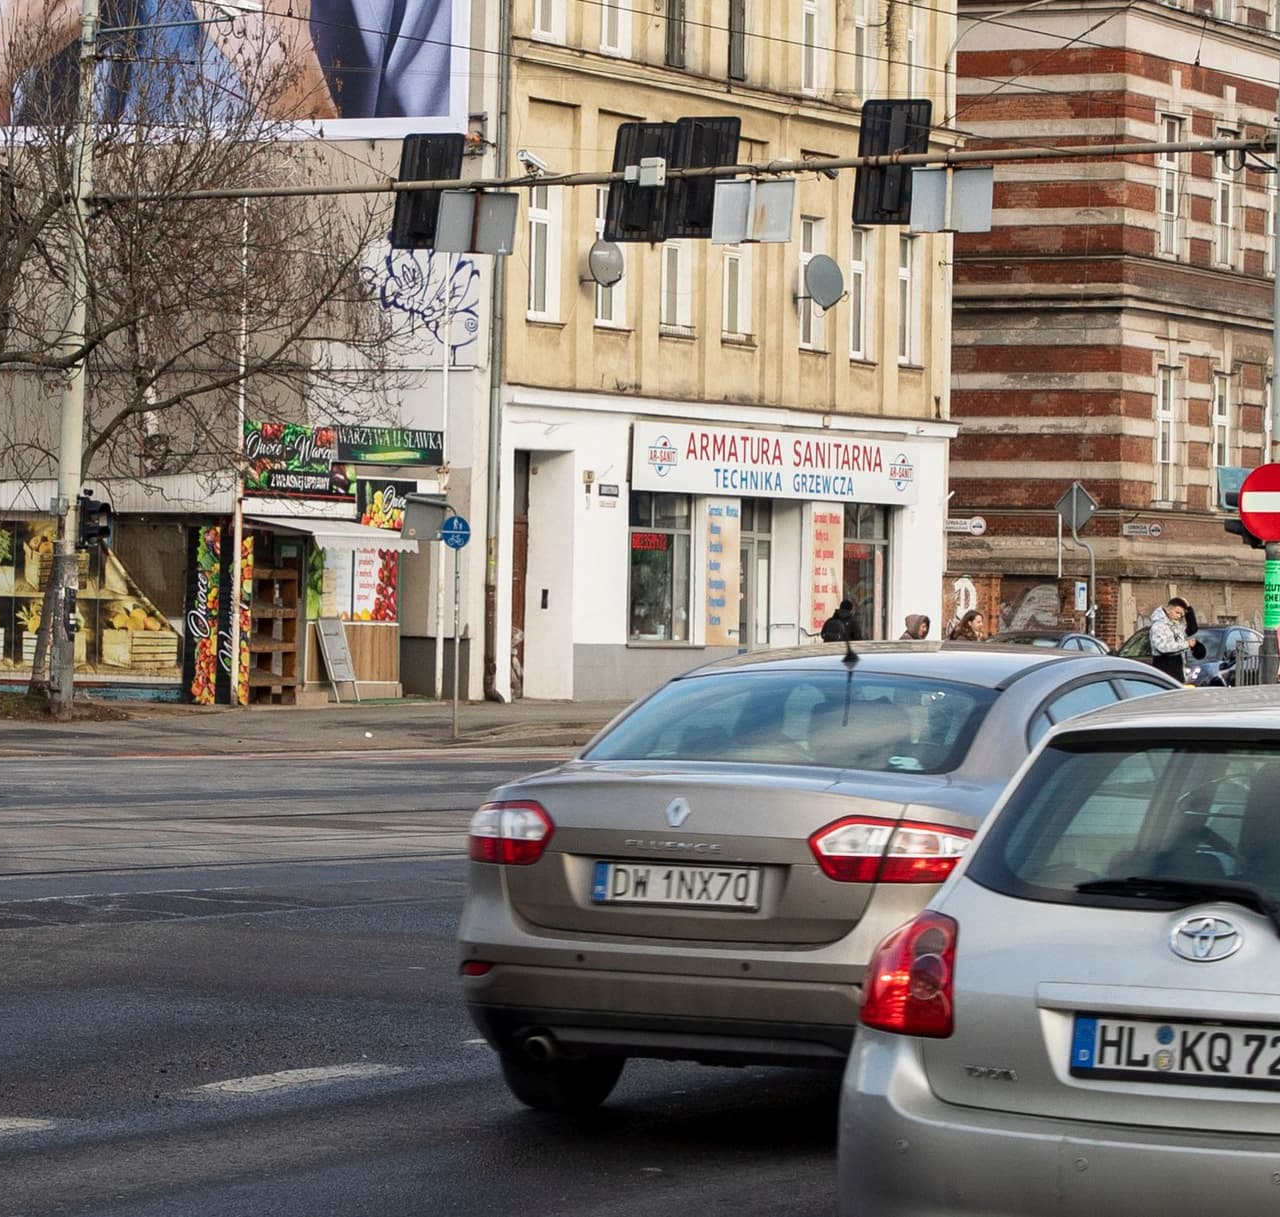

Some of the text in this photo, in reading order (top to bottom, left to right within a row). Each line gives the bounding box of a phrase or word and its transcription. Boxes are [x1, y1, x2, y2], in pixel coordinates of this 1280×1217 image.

[338, 427, 444, 451] WARZYWA U SŁAWKA
[686, 431, 883, 473] ARMATURA SANITARNA
[648, 448, 678, 463] AR-SANIT
[713, 468, 855, 497] TECHNIKA GRZEWCZA
[612, 867, 650, 898] DW
[663, 869, 750, 902] 1NX70
[1098, 1024, 1150, 1068] HL
[1179, 1030, 1232, 1073] KQ
